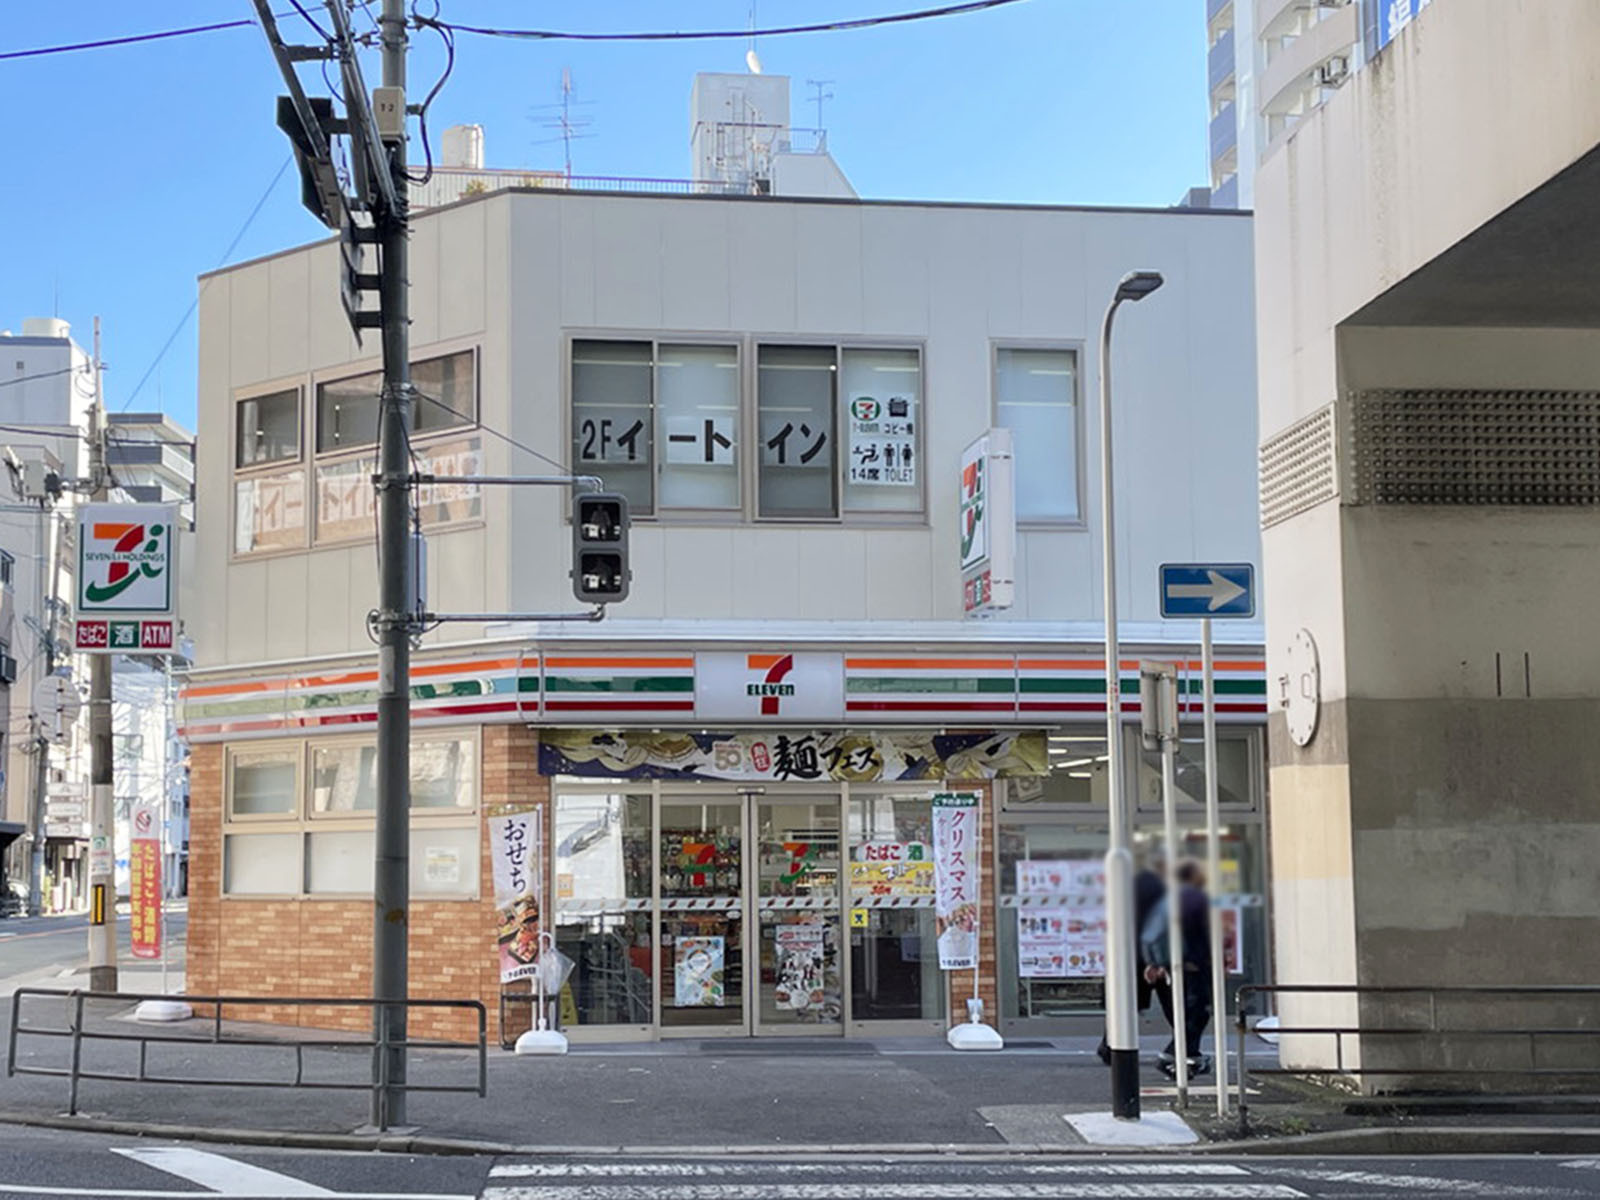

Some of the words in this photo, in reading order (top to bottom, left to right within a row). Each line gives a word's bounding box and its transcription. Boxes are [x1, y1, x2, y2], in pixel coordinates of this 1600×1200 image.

[78, 625, 106, 644] たばこ
[143, 625, 170, 645] ATM
[504, 819, 527, 894] おせち
[865, 844, 901, 860] たばこ
[950, 810, 966, 901] クリスマス
